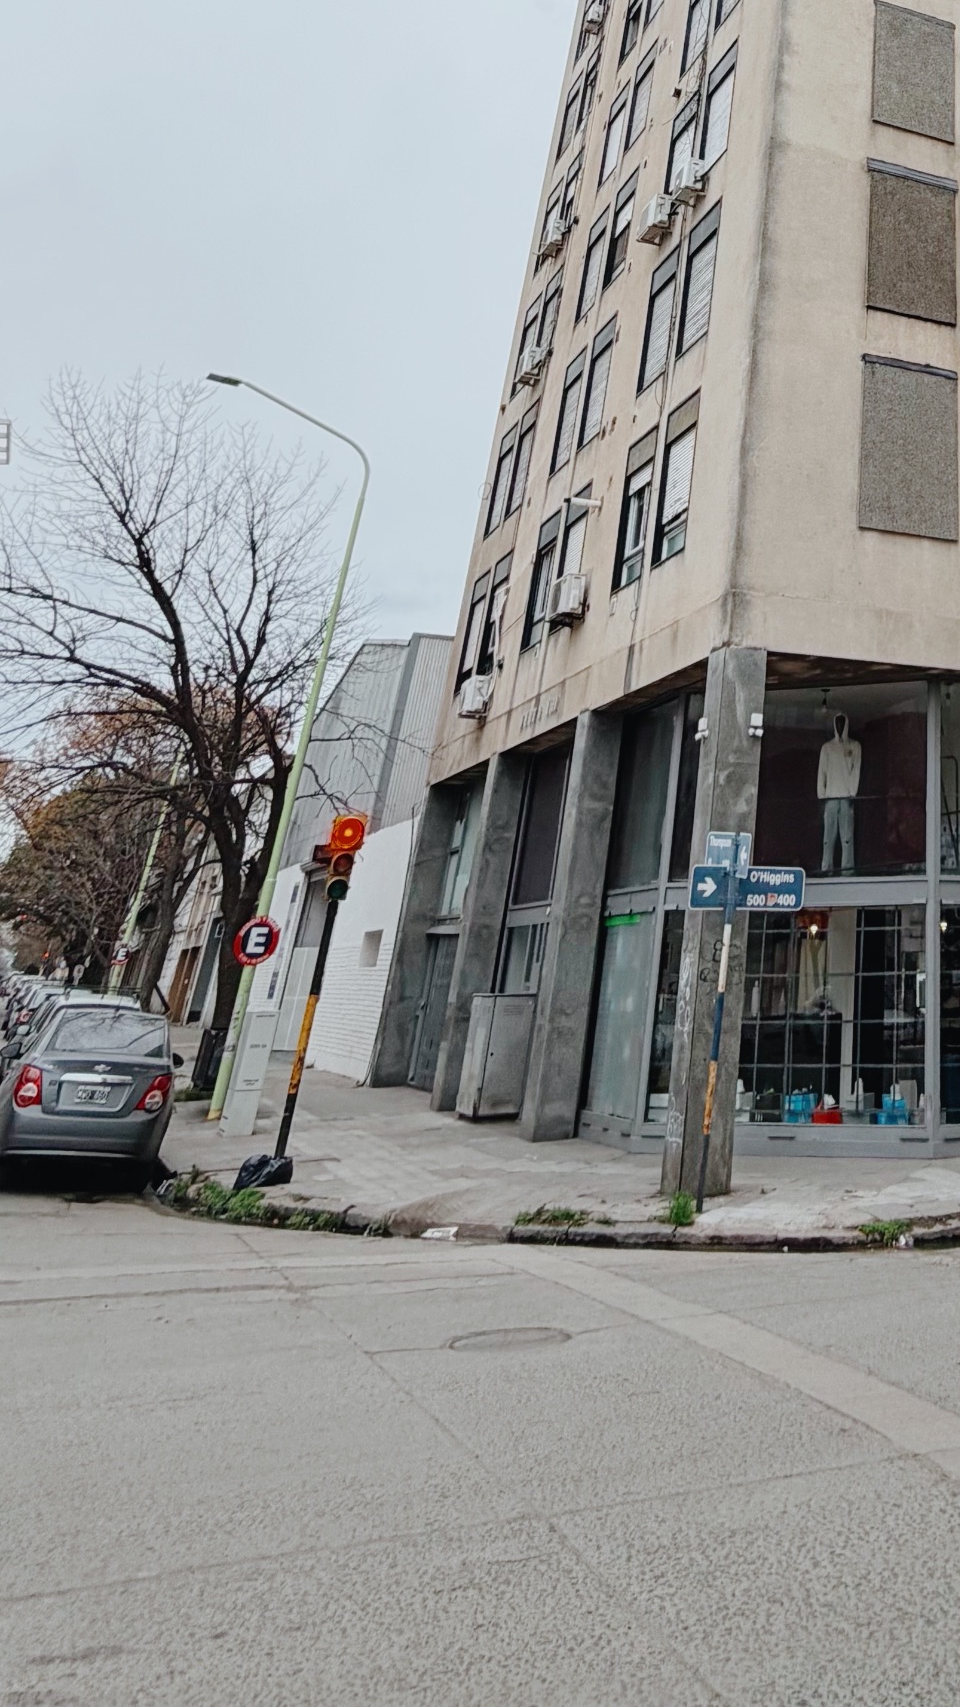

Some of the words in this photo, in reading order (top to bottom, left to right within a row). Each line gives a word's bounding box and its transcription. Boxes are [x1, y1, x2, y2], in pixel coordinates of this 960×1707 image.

[750, 871, 795, 885] O'Higgins
[746, 894, 766, 906] 500
[777, 894, 796, 906] 400
[245, 927, 270, 954] E
[116, 947, 128, 961] E
